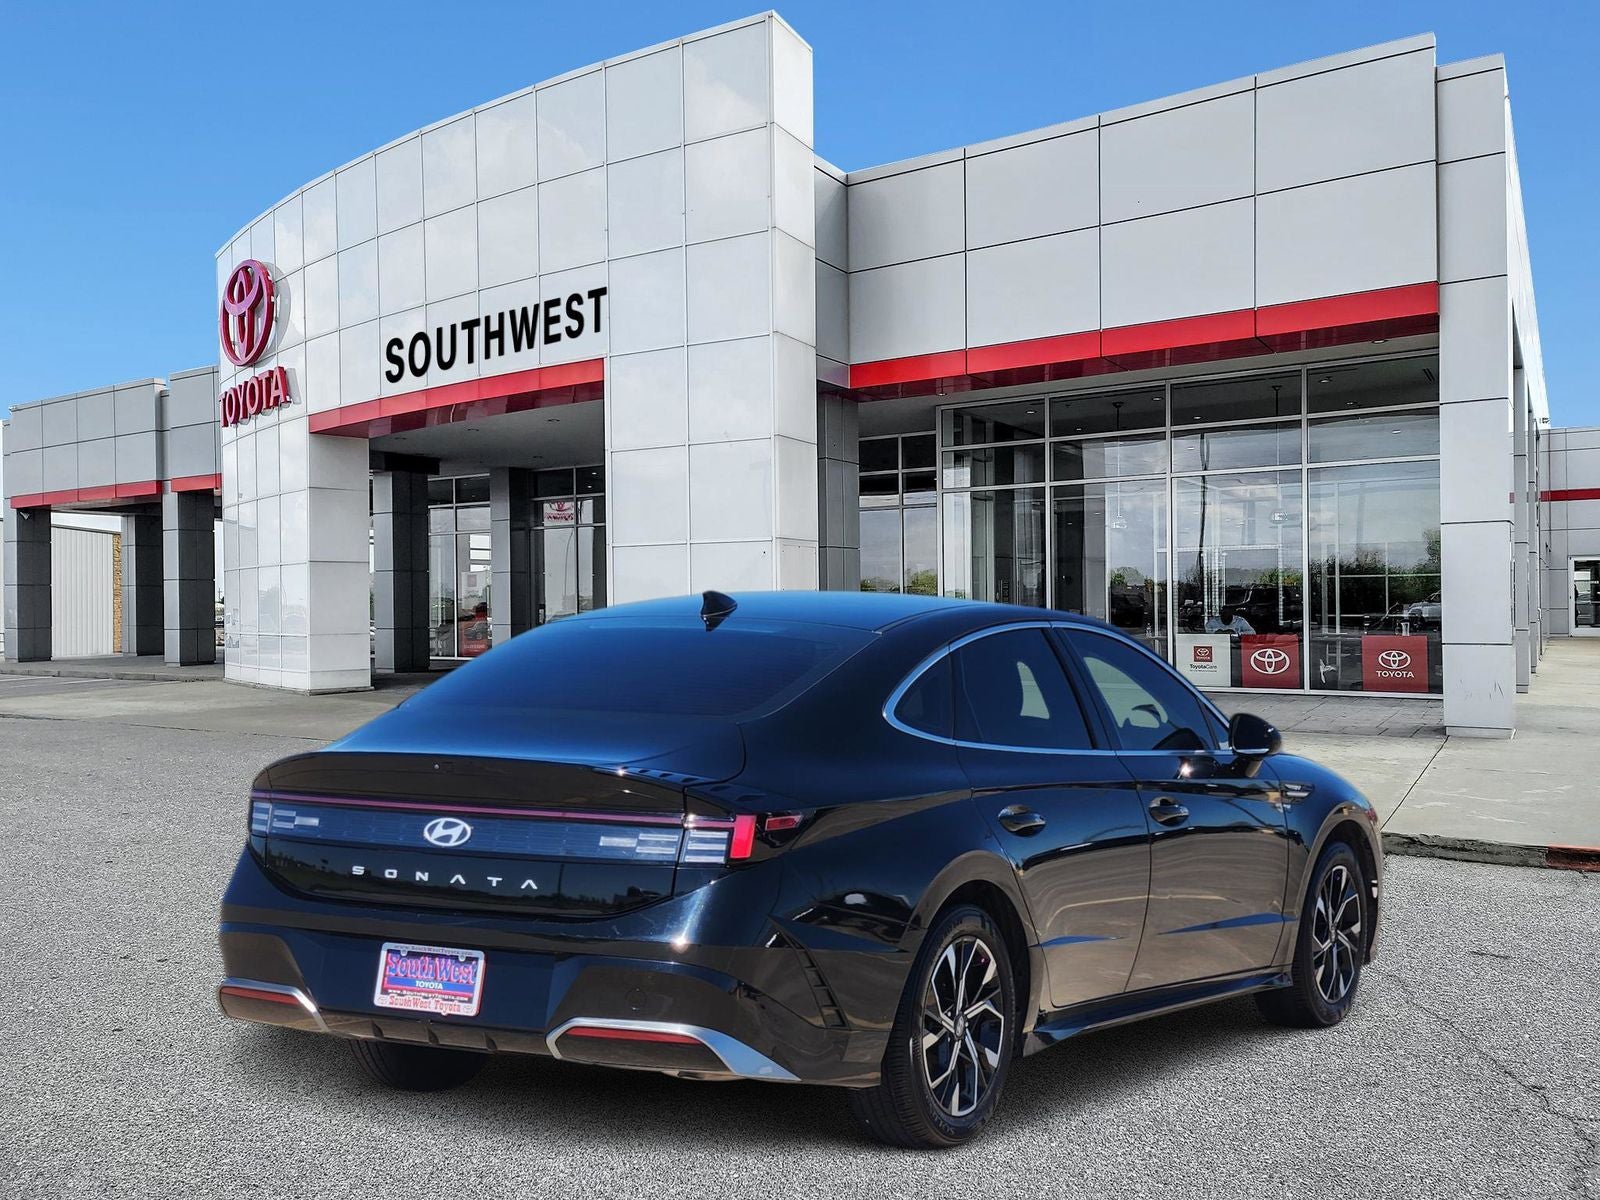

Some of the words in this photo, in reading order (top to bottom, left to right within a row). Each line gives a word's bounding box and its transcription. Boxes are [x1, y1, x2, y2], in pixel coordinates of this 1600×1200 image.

[385, 287, 608, 384] SOUTHWEST
[218, 366, 290, 428] TOYOTA
[1376, 671, 1415, 679] TOYOTA
[351, 865, 539, 890] SONATA
[415, 980, 443, 990] TOYOTA
[434, 1000, 461, 1013] Toyota
